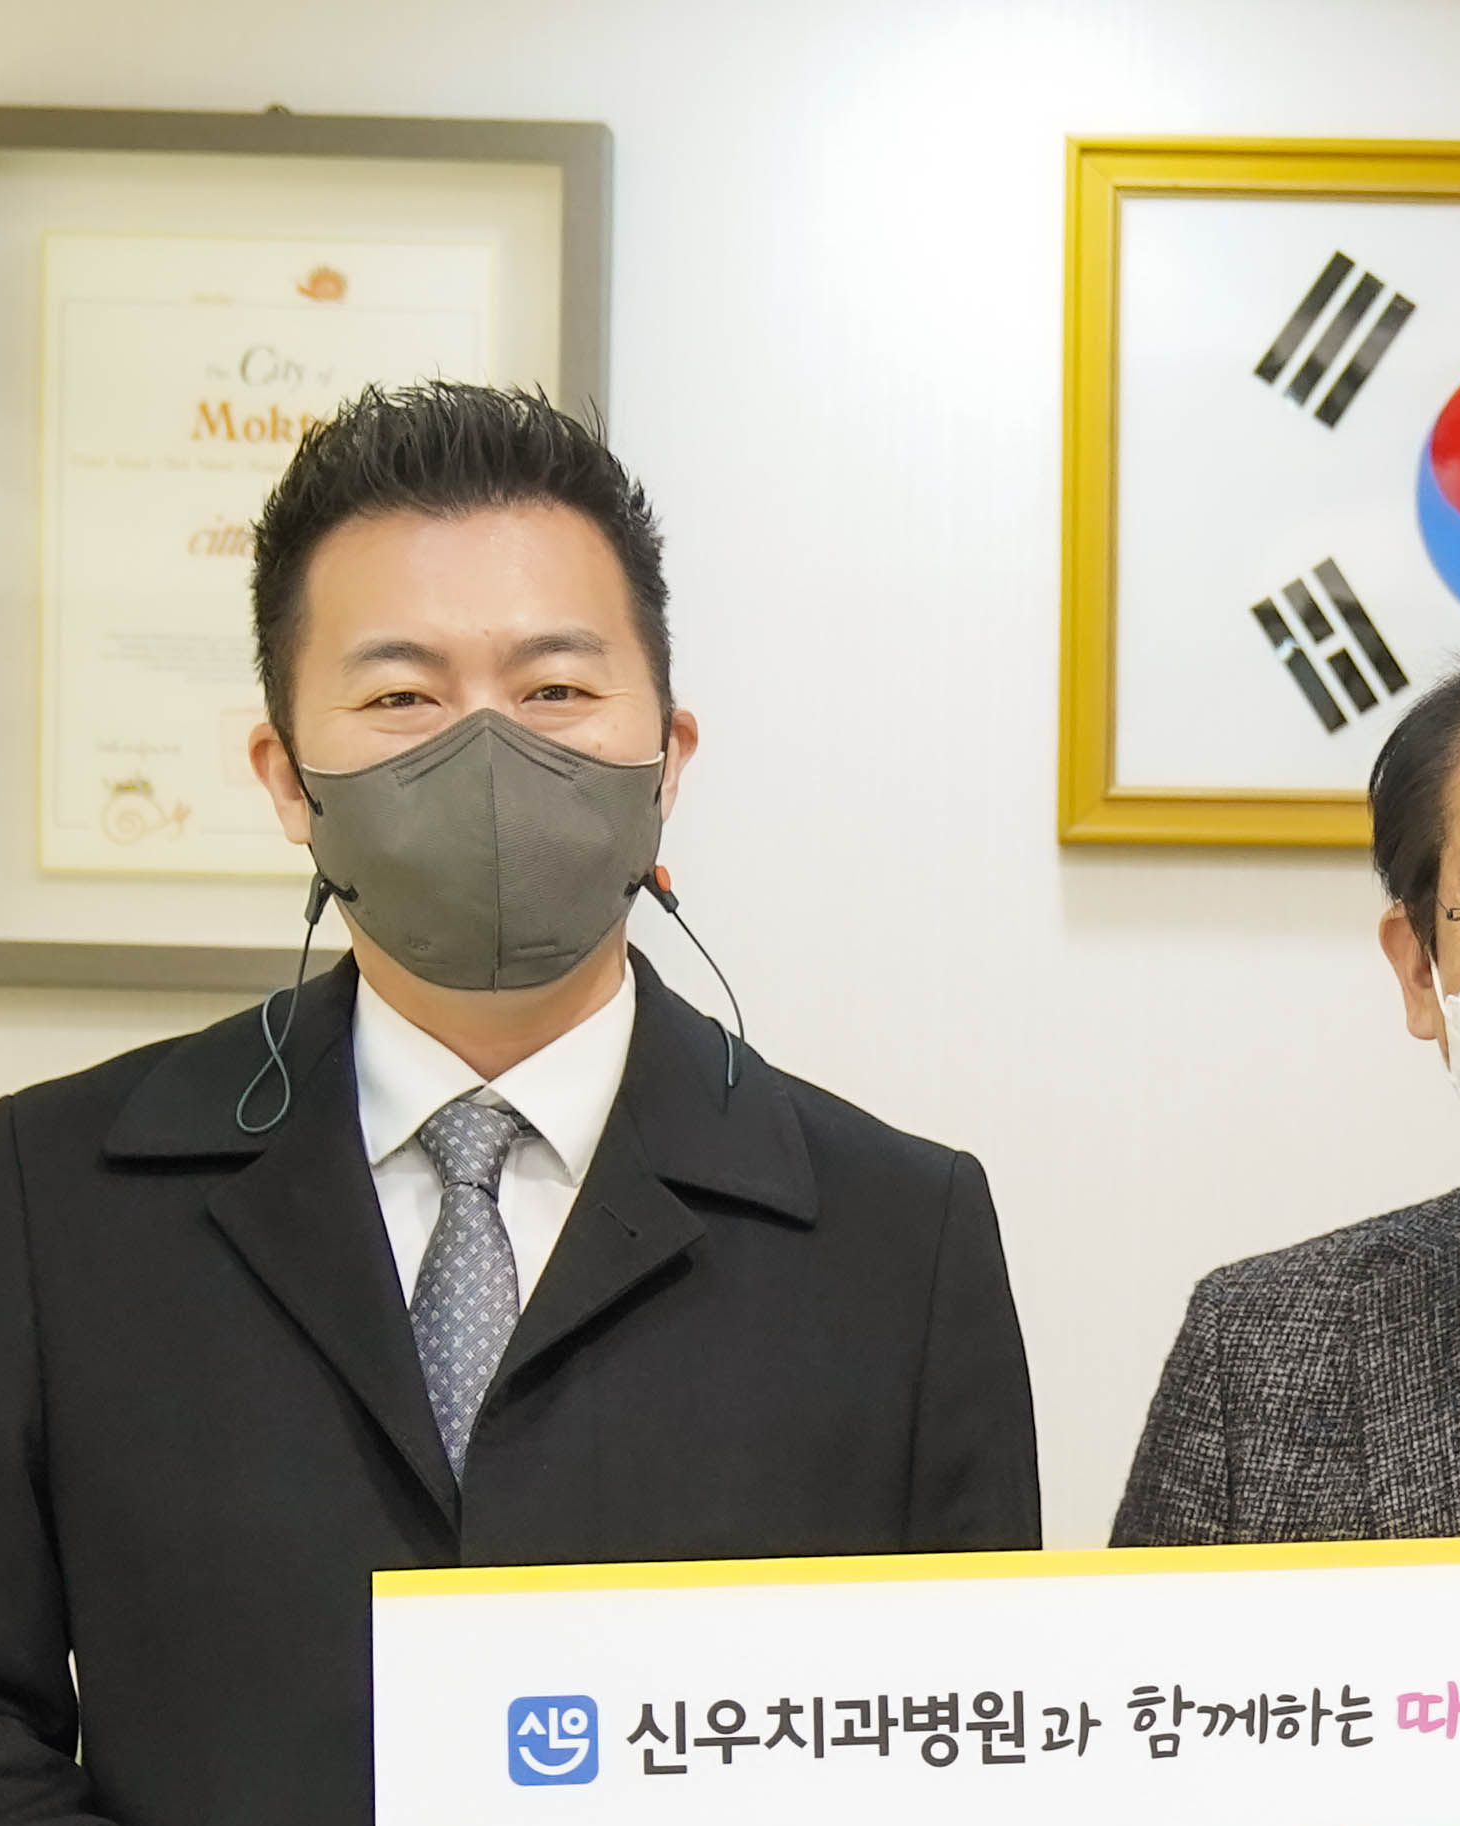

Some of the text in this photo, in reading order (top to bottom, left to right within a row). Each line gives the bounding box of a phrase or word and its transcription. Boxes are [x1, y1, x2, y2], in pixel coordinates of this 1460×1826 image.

[239, 344, 305, 392] City
[626, 1690, 1102, 1776] 신우치과병원과
[1127, 1684, 1374, 1759] 함께하는
